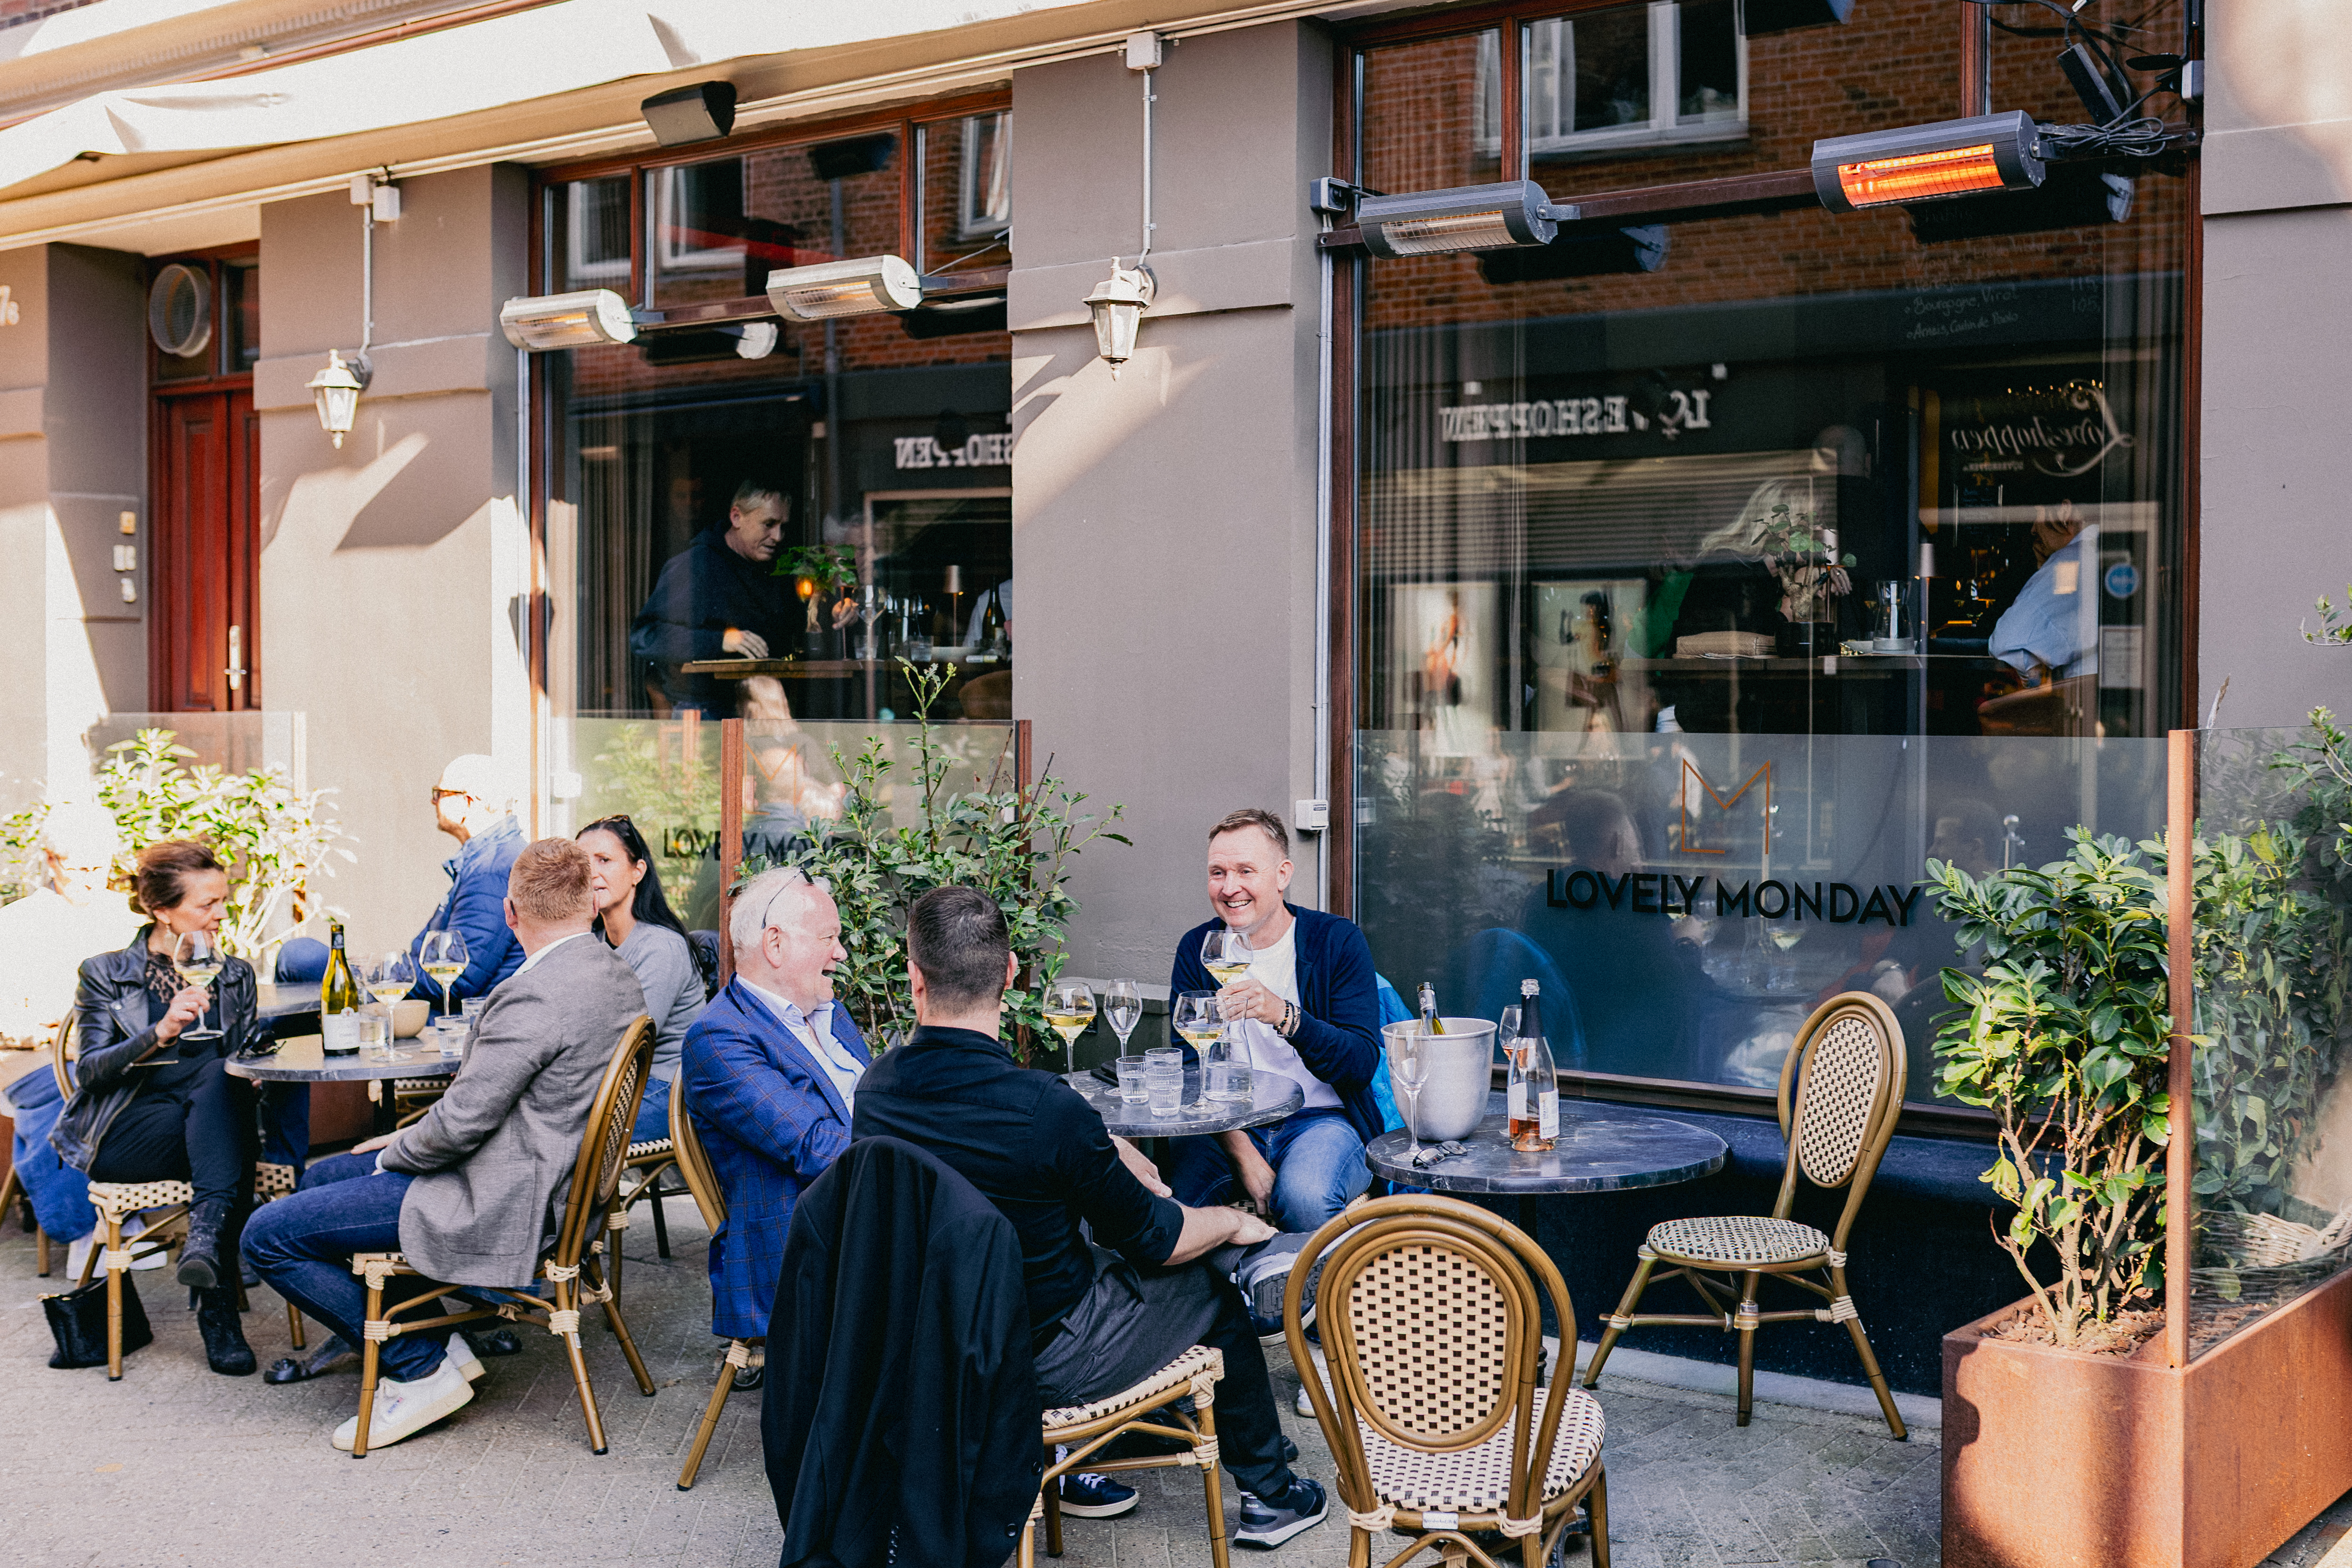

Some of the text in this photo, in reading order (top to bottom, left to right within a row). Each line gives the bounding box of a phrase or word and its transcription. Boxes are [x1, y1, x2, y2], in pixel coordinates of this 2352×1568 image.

[664, 829, 758, 861] LOVY
[1547, 869, 1921, 927] LOVELY MONDAY
